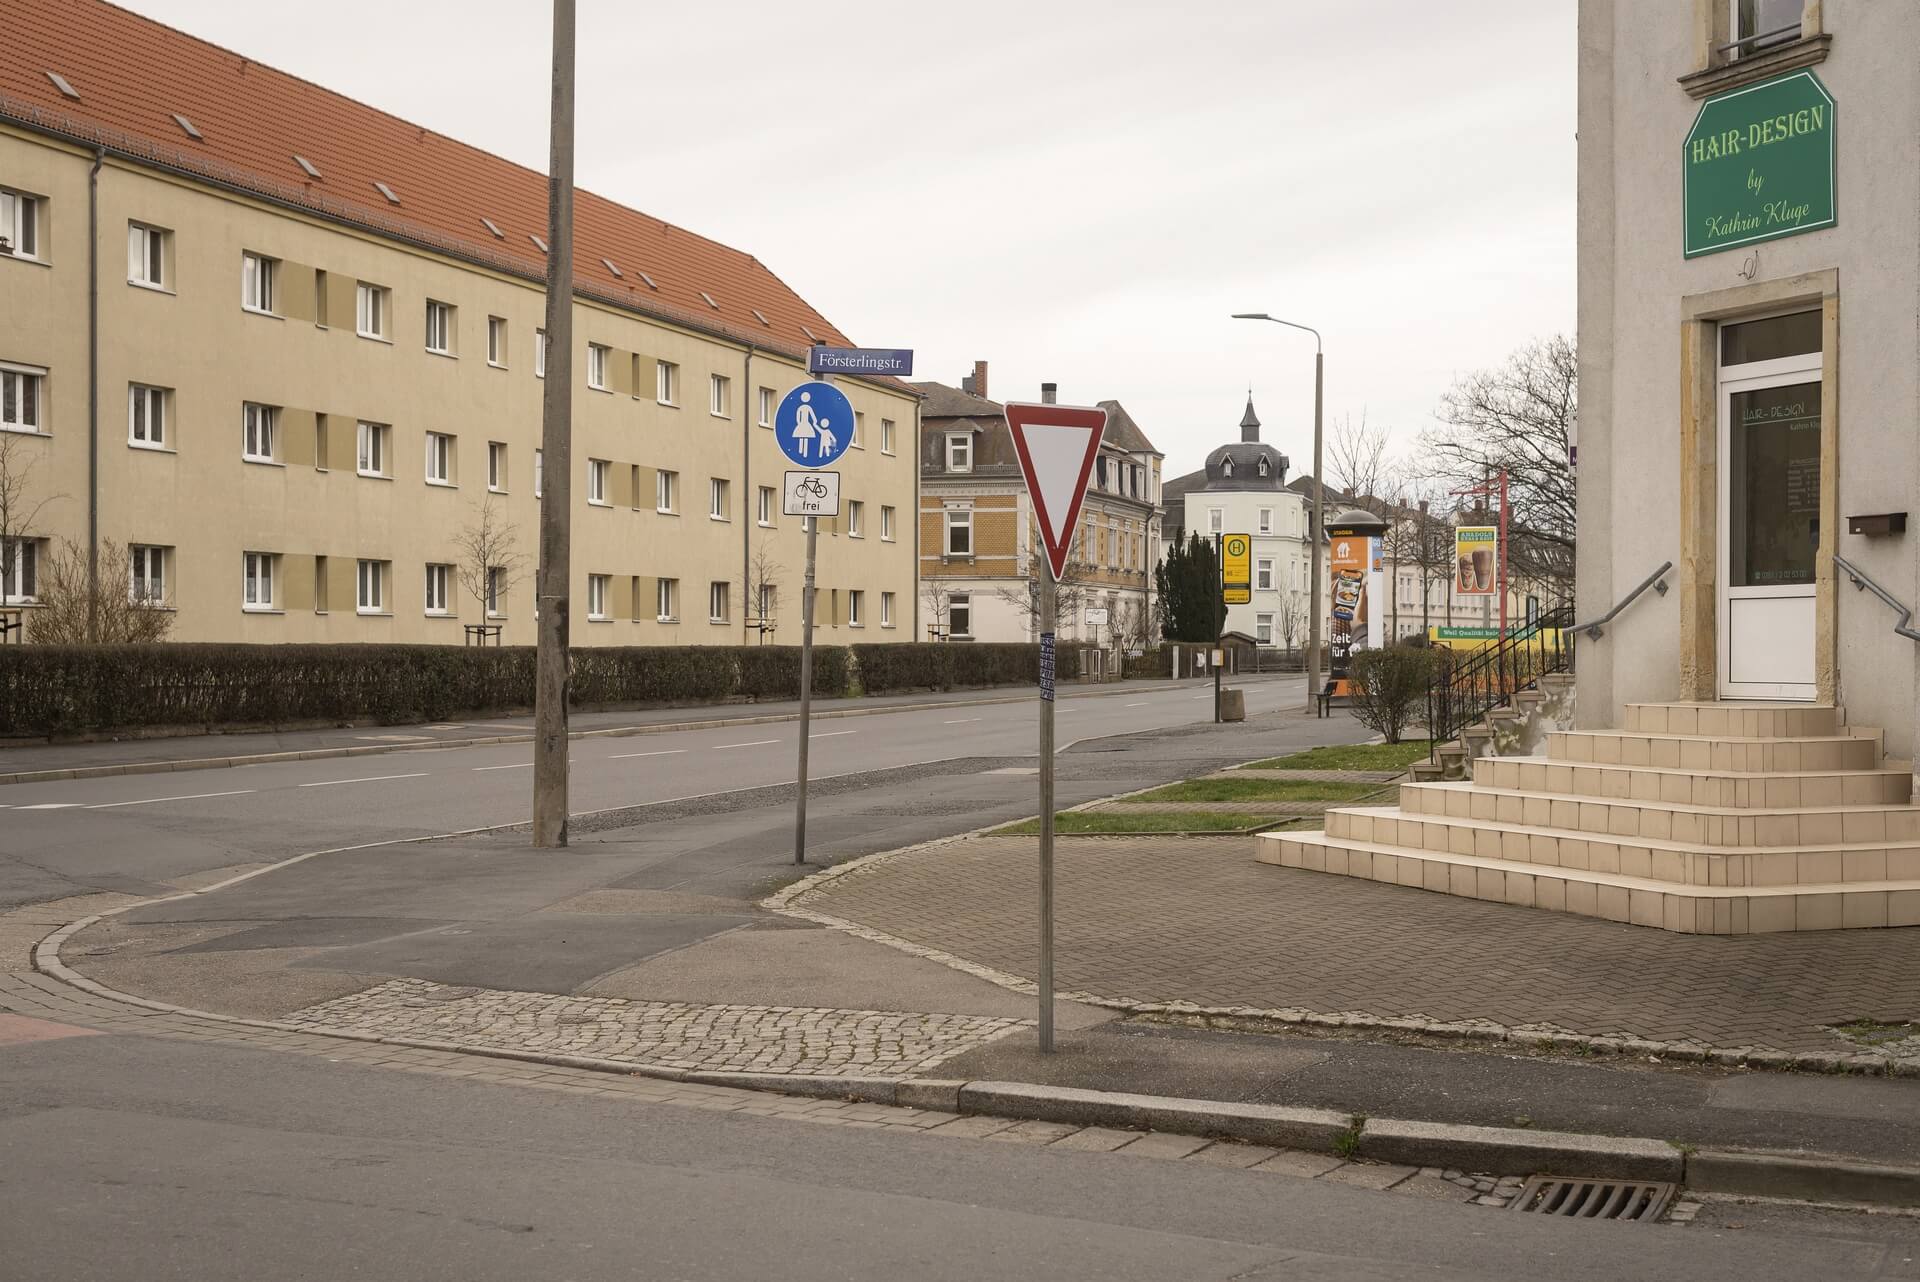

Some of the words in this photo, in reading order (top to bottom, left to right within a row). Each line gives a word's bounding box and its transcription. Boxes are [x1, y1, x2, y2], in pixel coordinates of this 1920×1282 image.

[1692, 104, 1825, 164] HAIR-DESIGN
[1747, 168, 1765, 196] by
[1705, 211, 1761, 239] Kathrin
[1763, 199, 1810, 226] Kluge
[819, 353, 904, 371] Försterlingstr.
[803, 500, 820, 511] frei
[1332, 632, 1351, 644] Zeit
[1332, 646, 1345, 657] für
